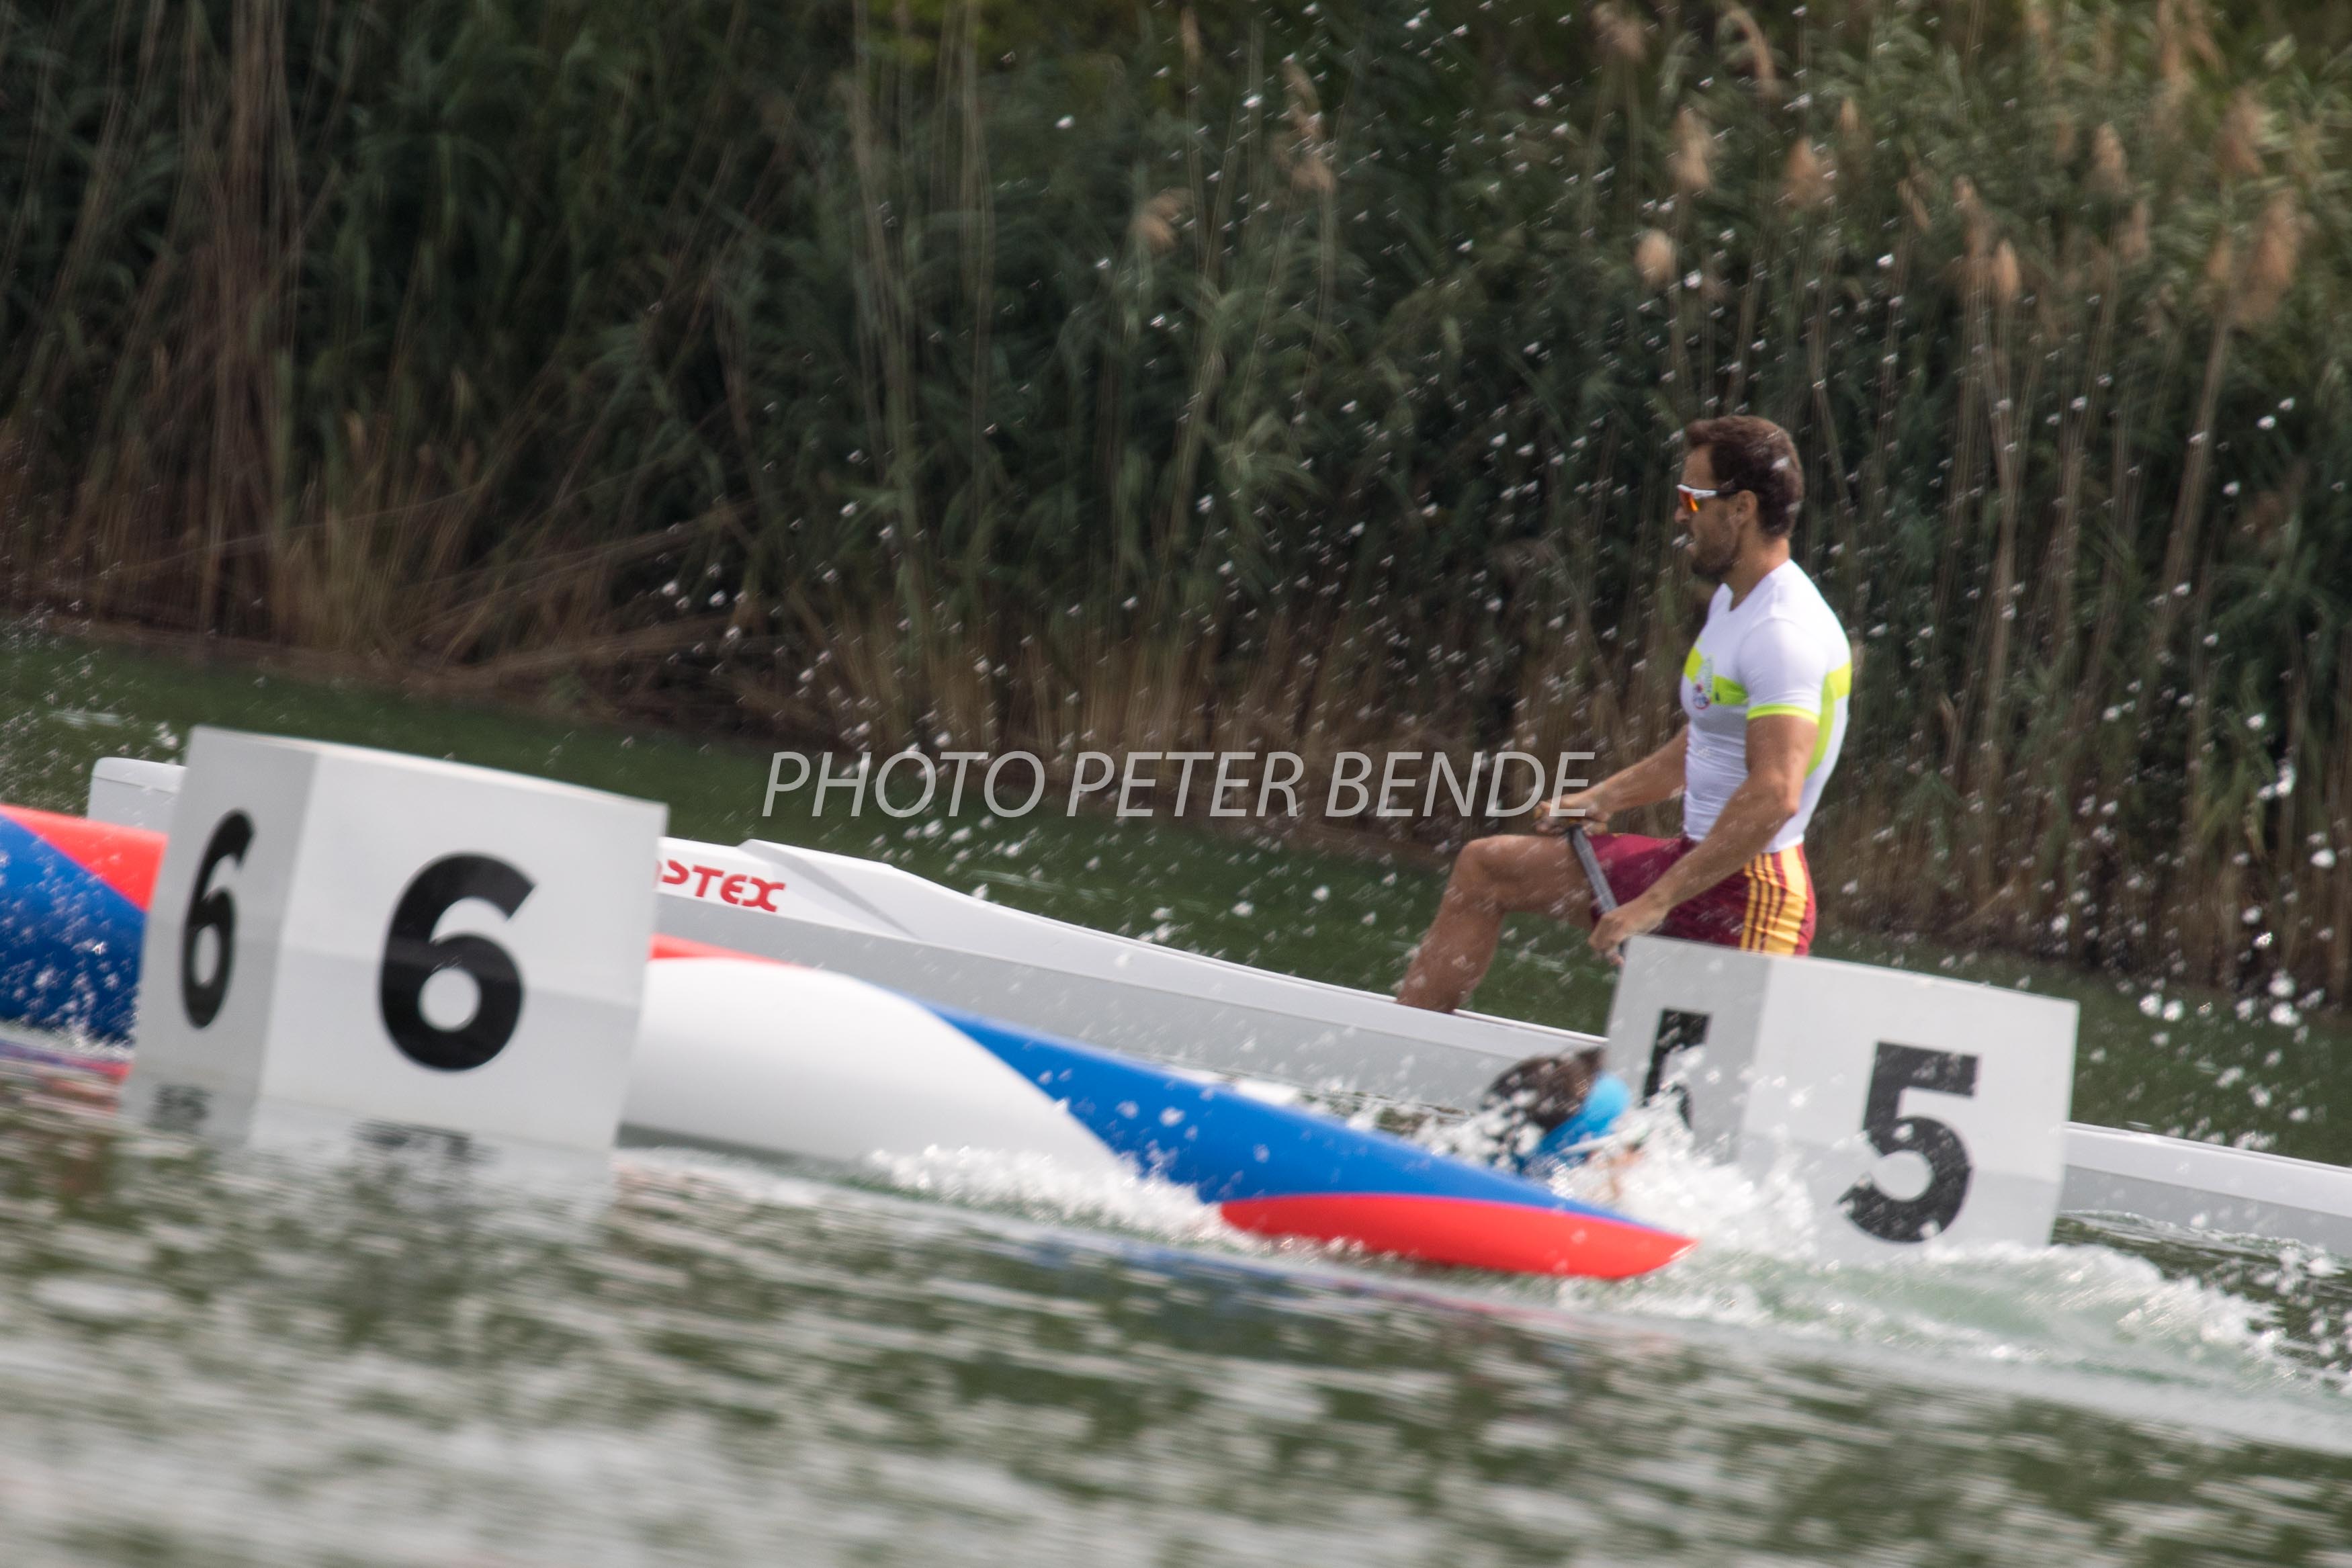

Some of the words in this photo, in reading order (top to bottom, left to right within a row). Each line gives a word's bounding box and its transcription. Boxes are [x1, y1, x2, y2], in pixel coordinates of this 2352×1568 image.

[182, 809, 256, 1029] 6
[378, 851, 537, 1072] 6
[654, 859, 786, 912] STEX
[1837, 1041, 1979, 1244] 5
